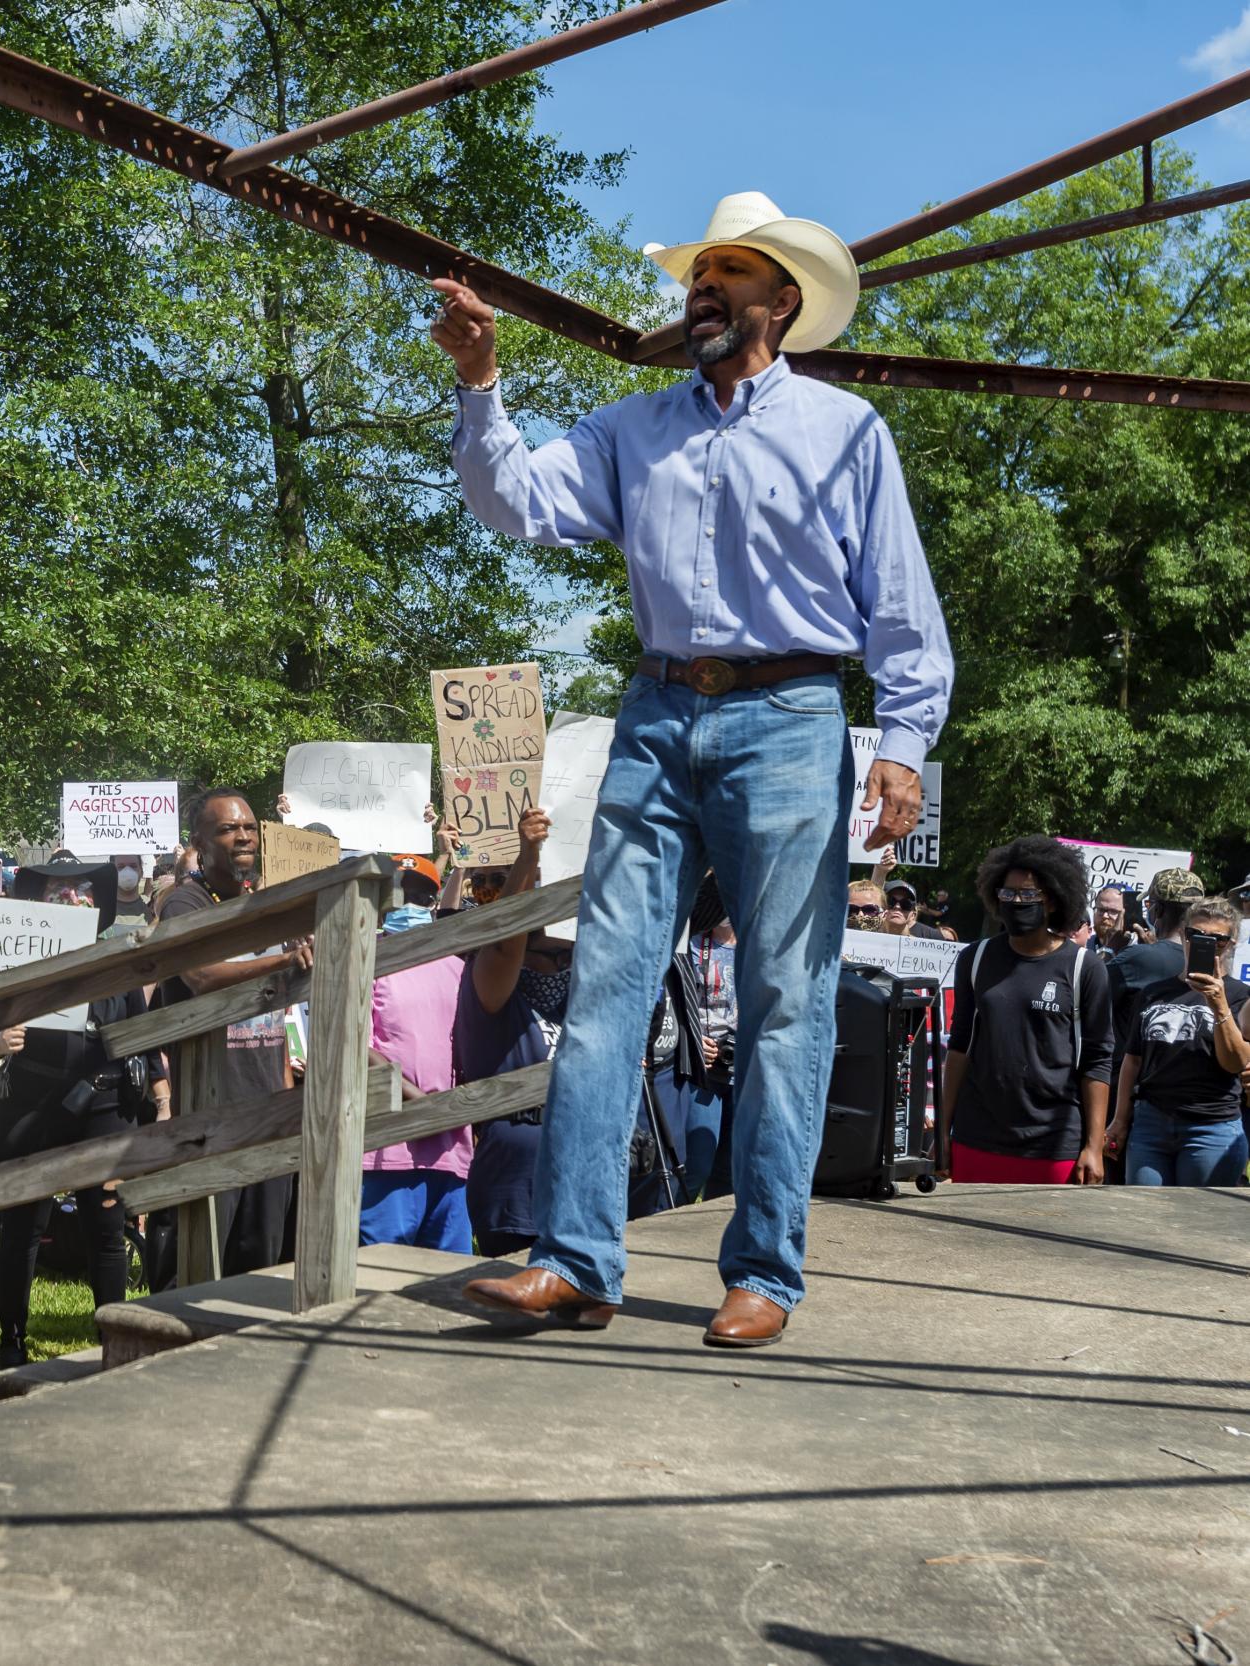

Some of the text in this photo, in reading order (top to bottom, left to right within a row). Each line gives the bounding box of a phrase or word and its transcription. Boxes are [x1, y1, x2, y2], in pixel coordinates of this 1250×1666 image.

[443, 680, 538, 721] SPREAD
[451, 735, 540, 774] KINDNESS
[300, 757, 415, 788] LEGALISE
[88, 784, 122, 796] THIS
[320, 791, 387, 812] BEING
[69, 795, 176, 814] AGGRESSION
[452, 787, 534, 837] BLM
[84, 814, 126, 827] WILL
[894, 834, 939, 865] NCE
[1090, 854, 1139, 878] ONE
[21, 915, 33, 927] is
[40, 920, 51, 928] a
